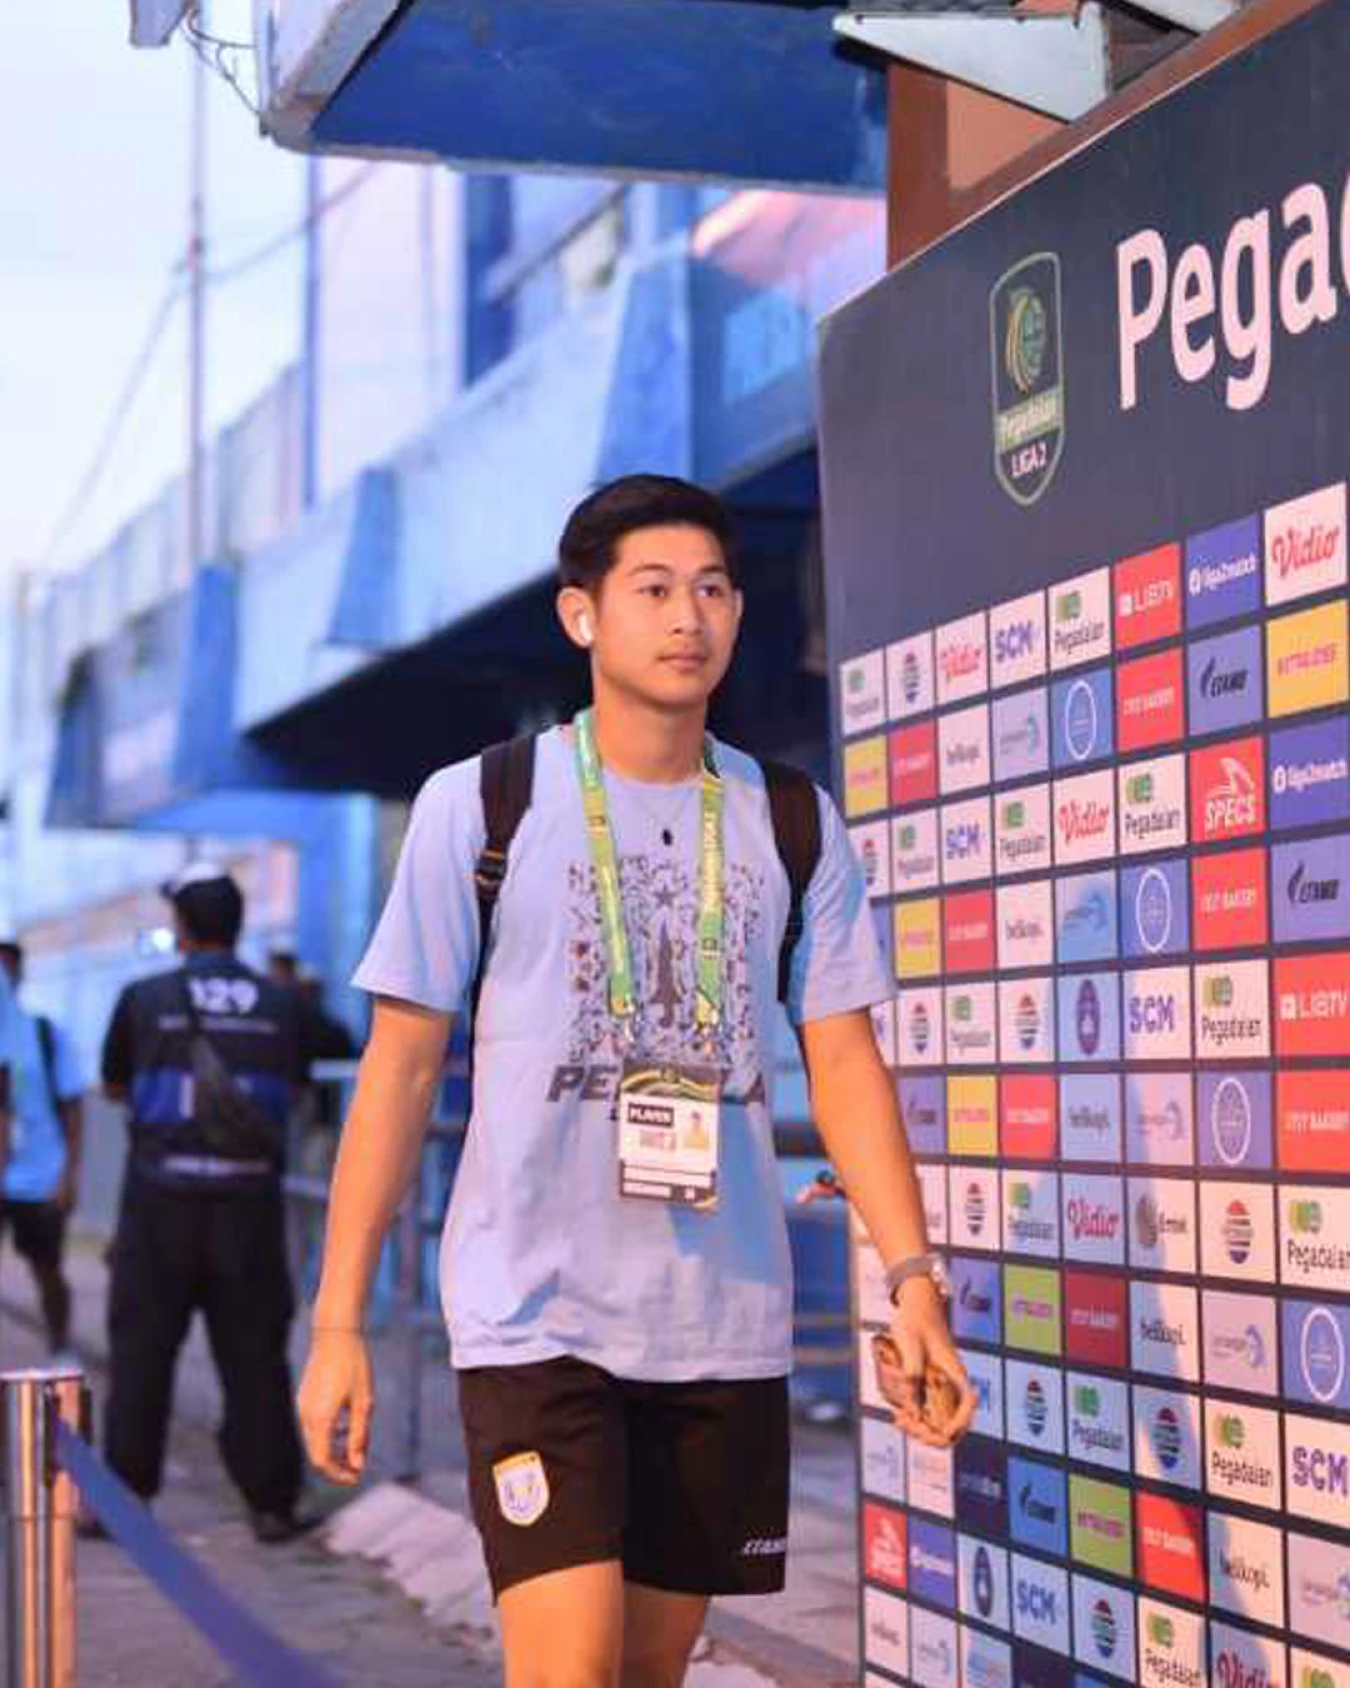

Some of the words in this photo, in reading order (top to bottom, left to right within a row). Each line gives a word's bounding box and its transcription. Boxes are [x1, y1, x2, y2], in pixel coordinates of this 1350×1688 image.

[1116, 172, 1350, 411] Pega
[1271, 526, 1340, 579] Vidio
[995, 620, 1033, 663] SCM
[1059, 798, 1110, 845] Vidio
[1124, 808, 1181, 840] Pegadaian
[1204, 796, 1256, 834] SPECS
[946, 823, 981, 860] SCM
[1129, 994, 1175, 1035] SCM
[1201, 1015, 1262, 1047] Pegadaian
[1067, 1196, 1119, 1239] Vidio
[1211, 1450, 1272, 1488] Pegadaian
[1291, 1445, 1349, 1498] SCM
[1016, 1579, 1057, 1625] SCM
[1216, 1650, 1281, 1688] Vidi
